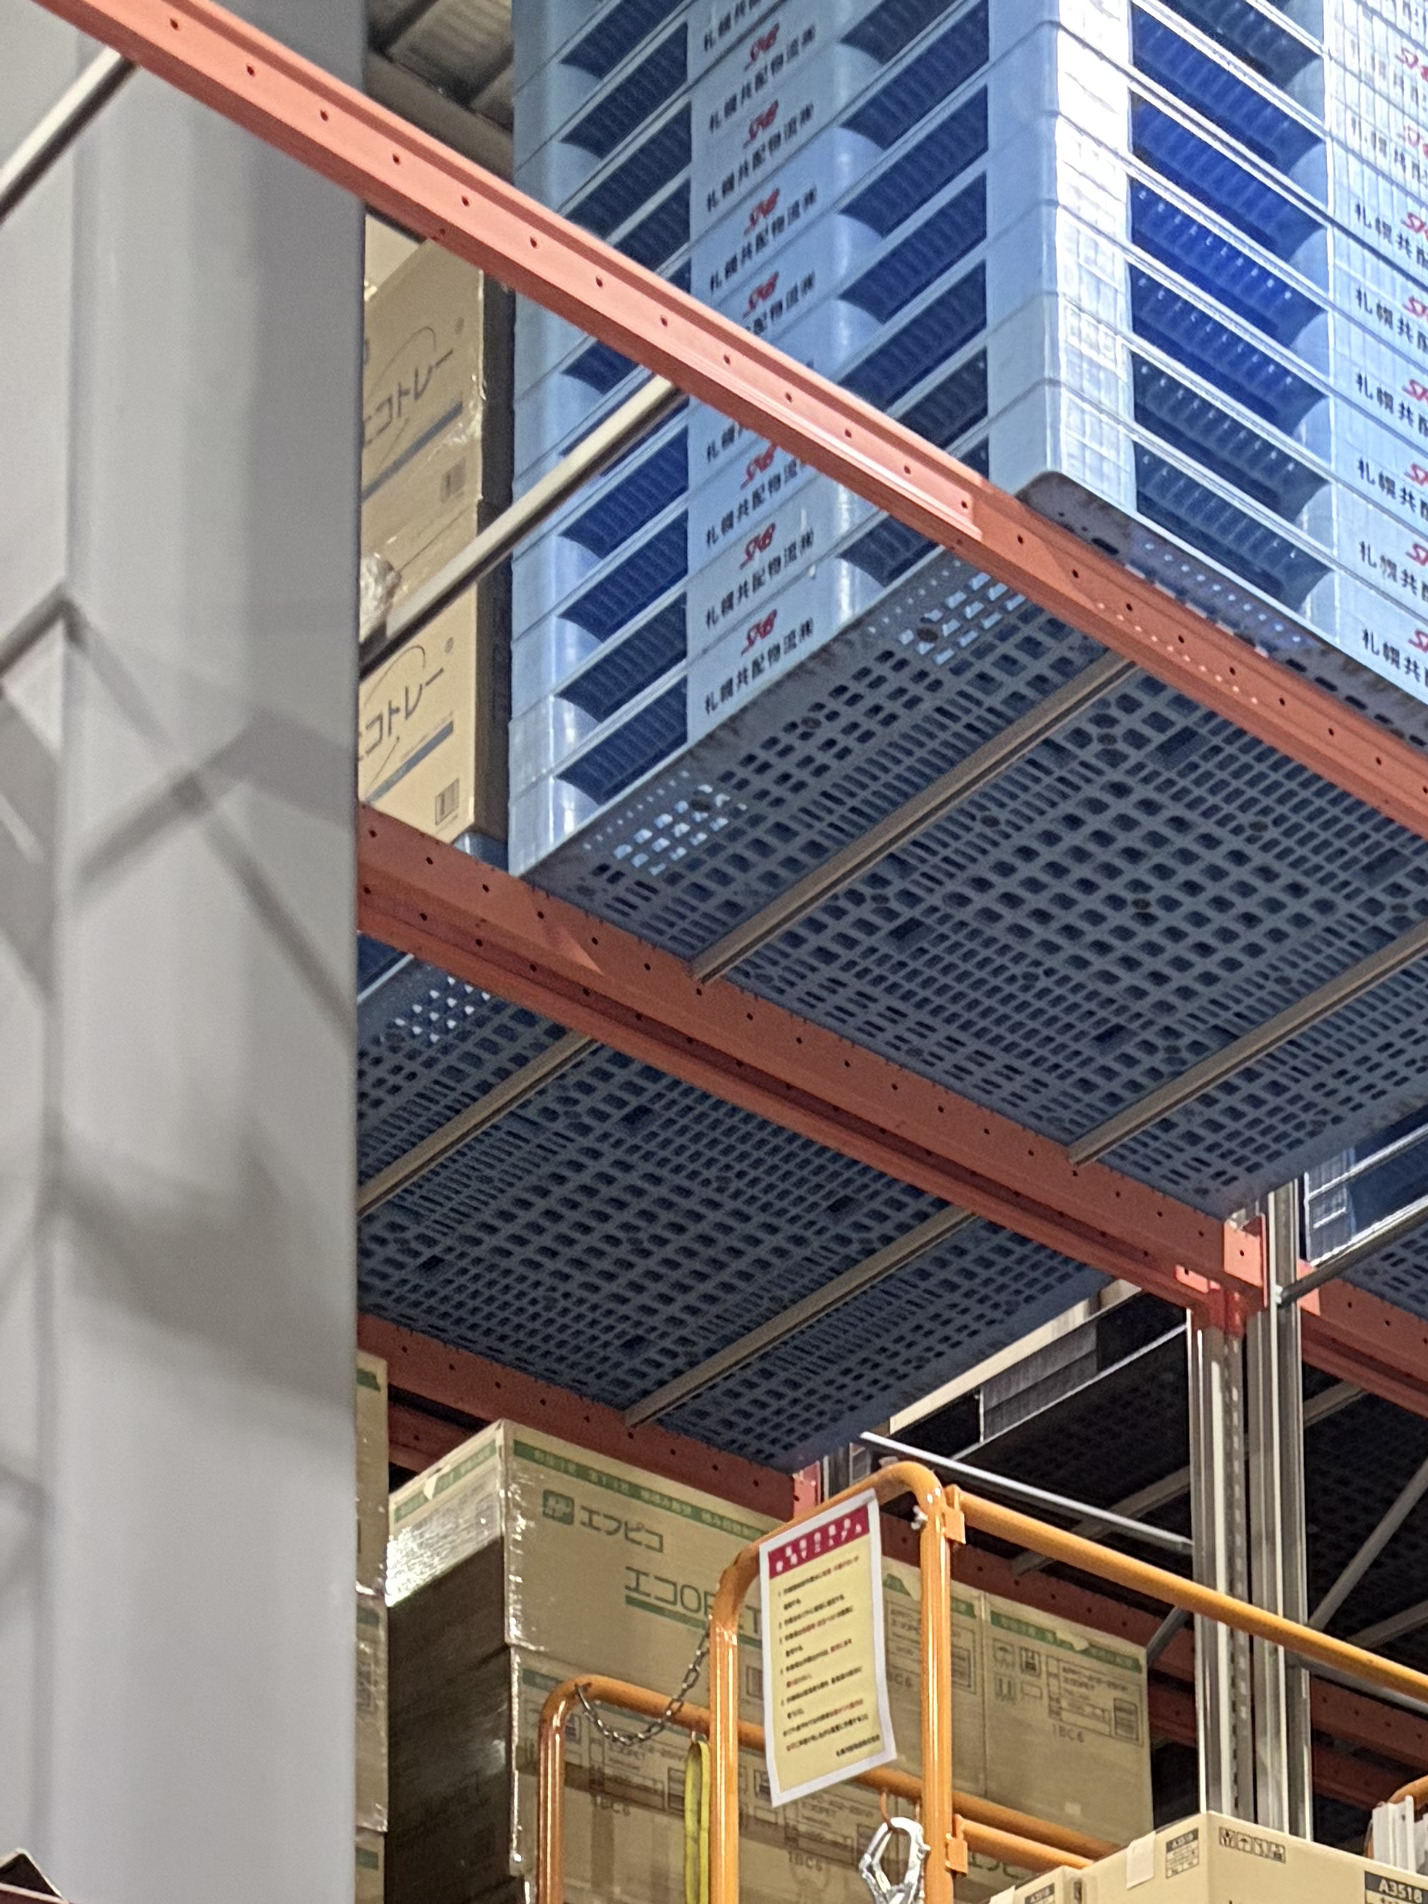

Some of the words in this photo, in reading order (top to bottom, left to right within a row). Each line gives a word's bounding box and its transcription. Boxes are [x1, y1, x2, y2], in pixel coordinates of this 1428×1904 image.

[580, 1506, 663, 1553] エフピコ
[1379, 1879, 1422, 1903] A3518
